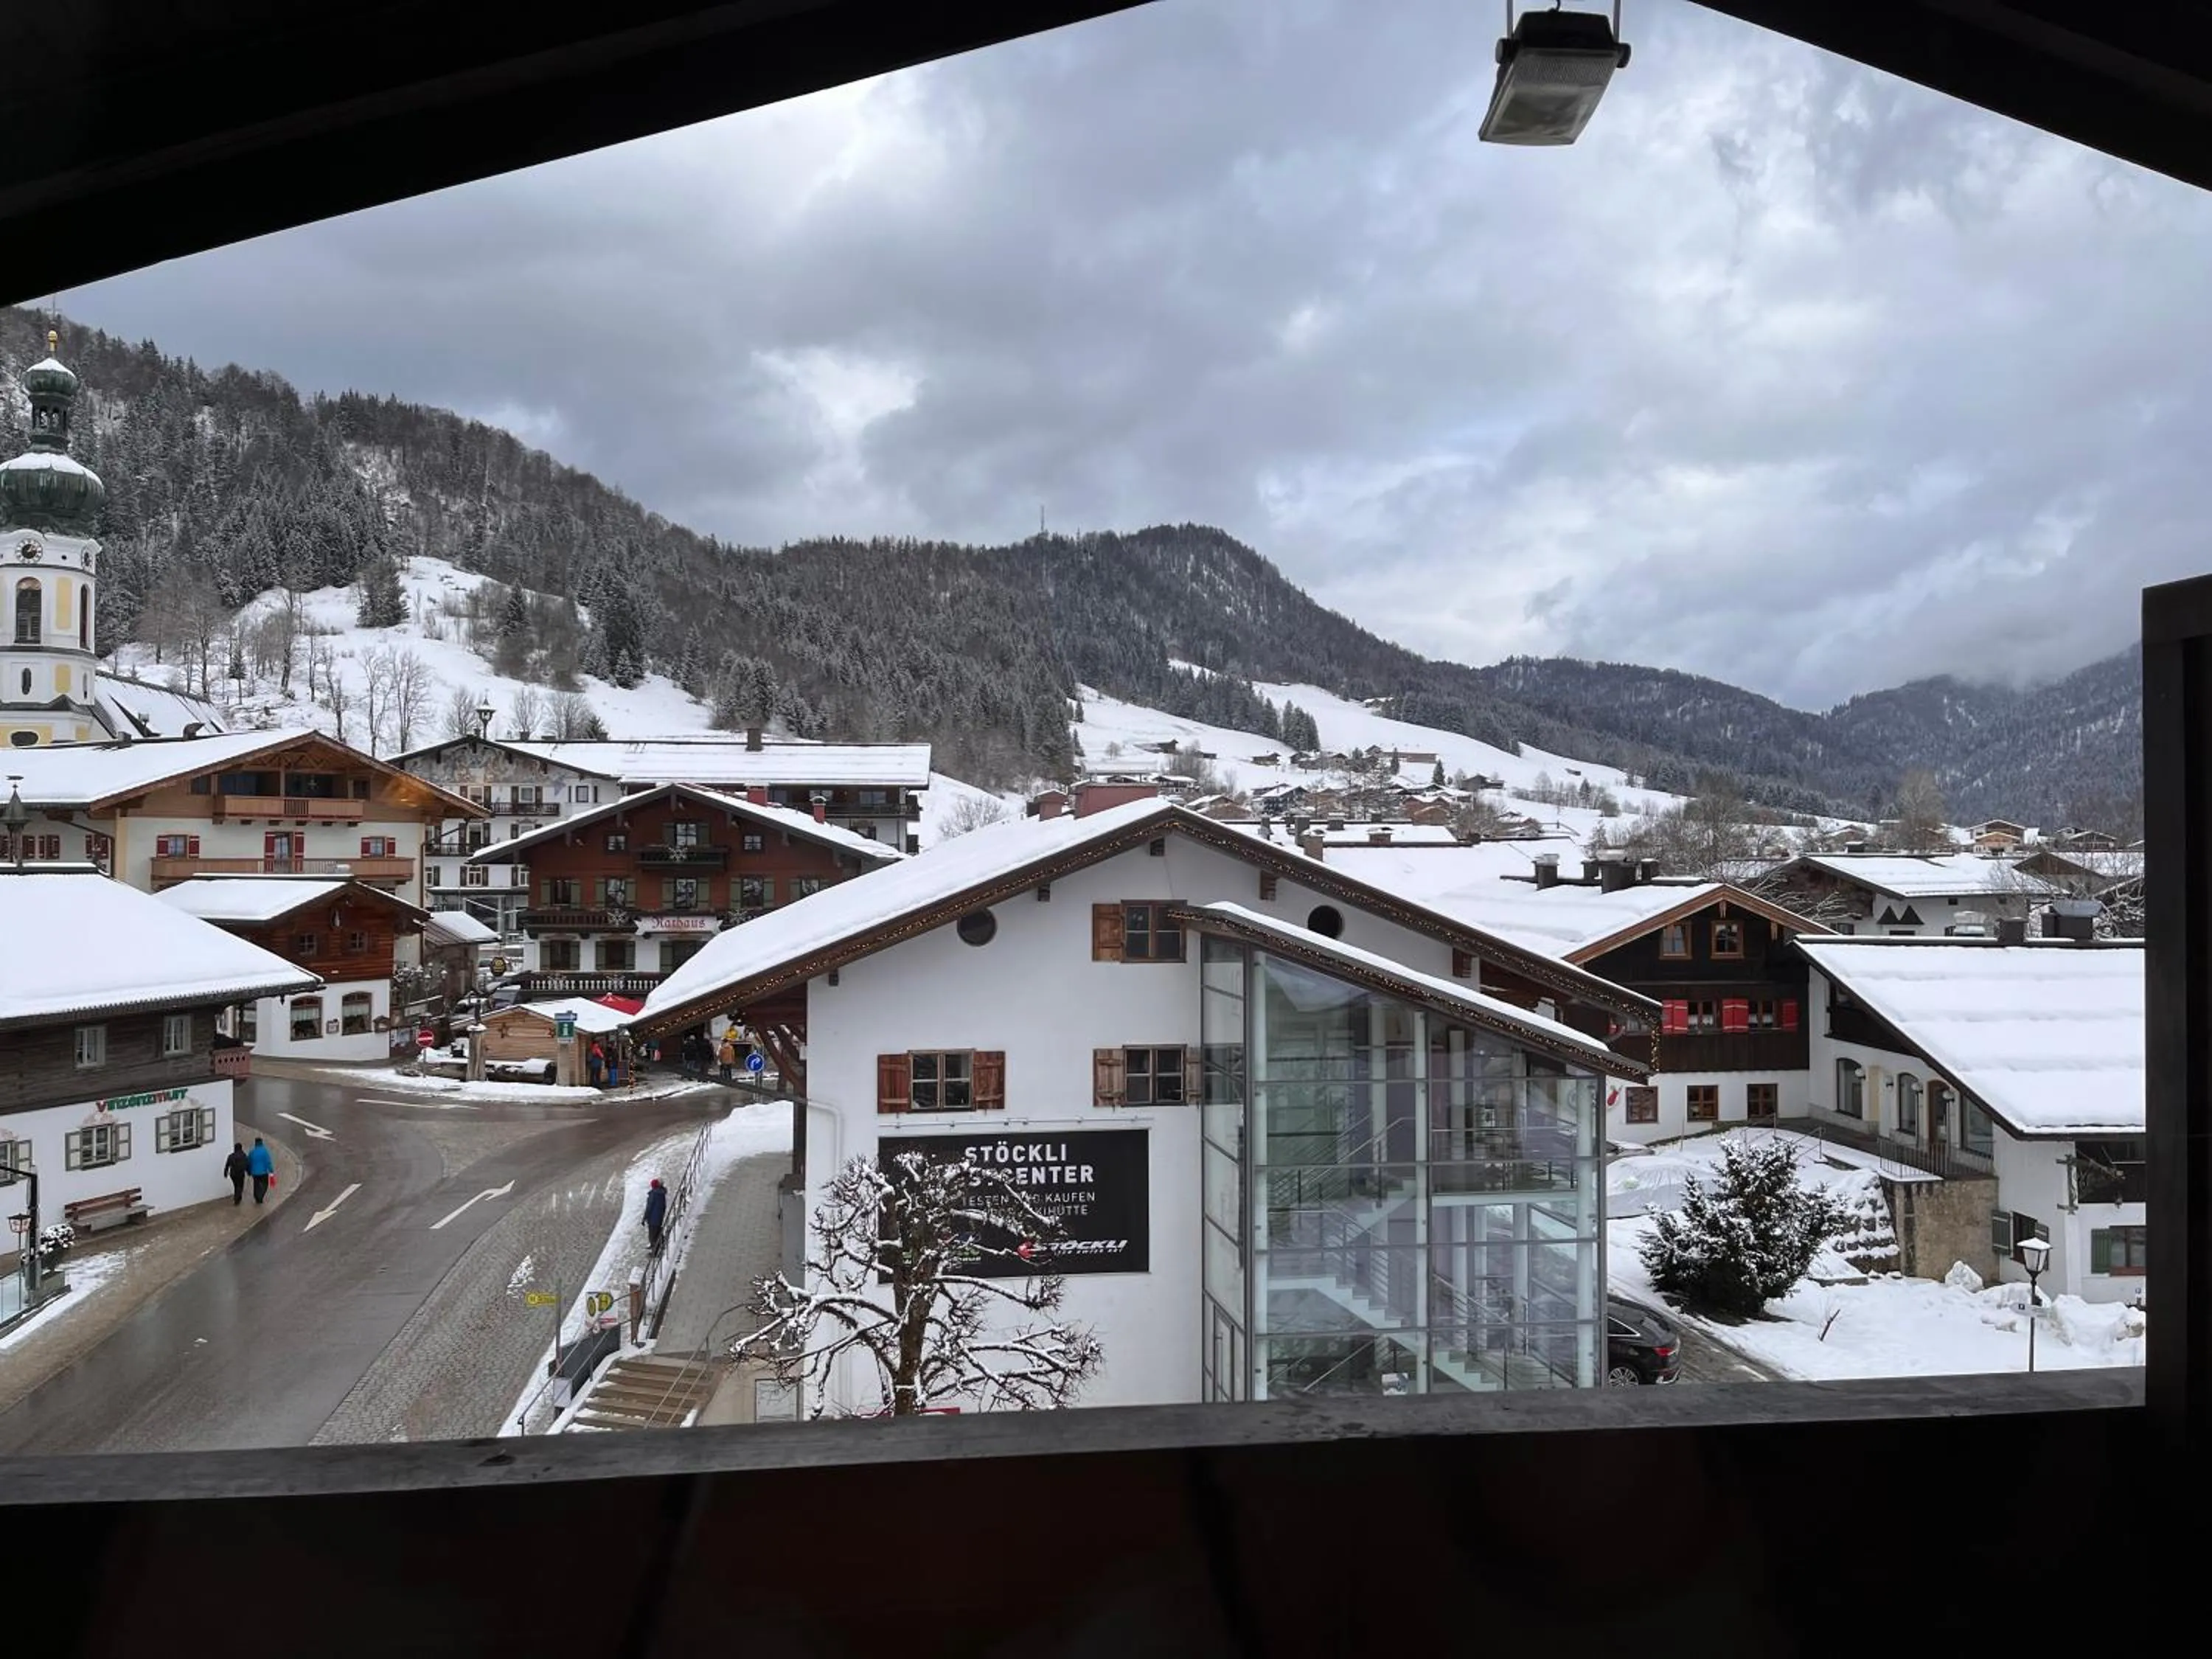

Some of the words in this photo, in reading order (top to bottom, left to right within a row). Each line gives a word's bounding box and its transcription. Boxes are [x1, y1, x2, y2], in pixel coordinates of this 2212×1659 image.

[651, 917, 706, 928] Rathaus
[965, 1141, 1067, 1163] STÖCKLI
[1045, 1192, 1095, 1203] KAUFEN
